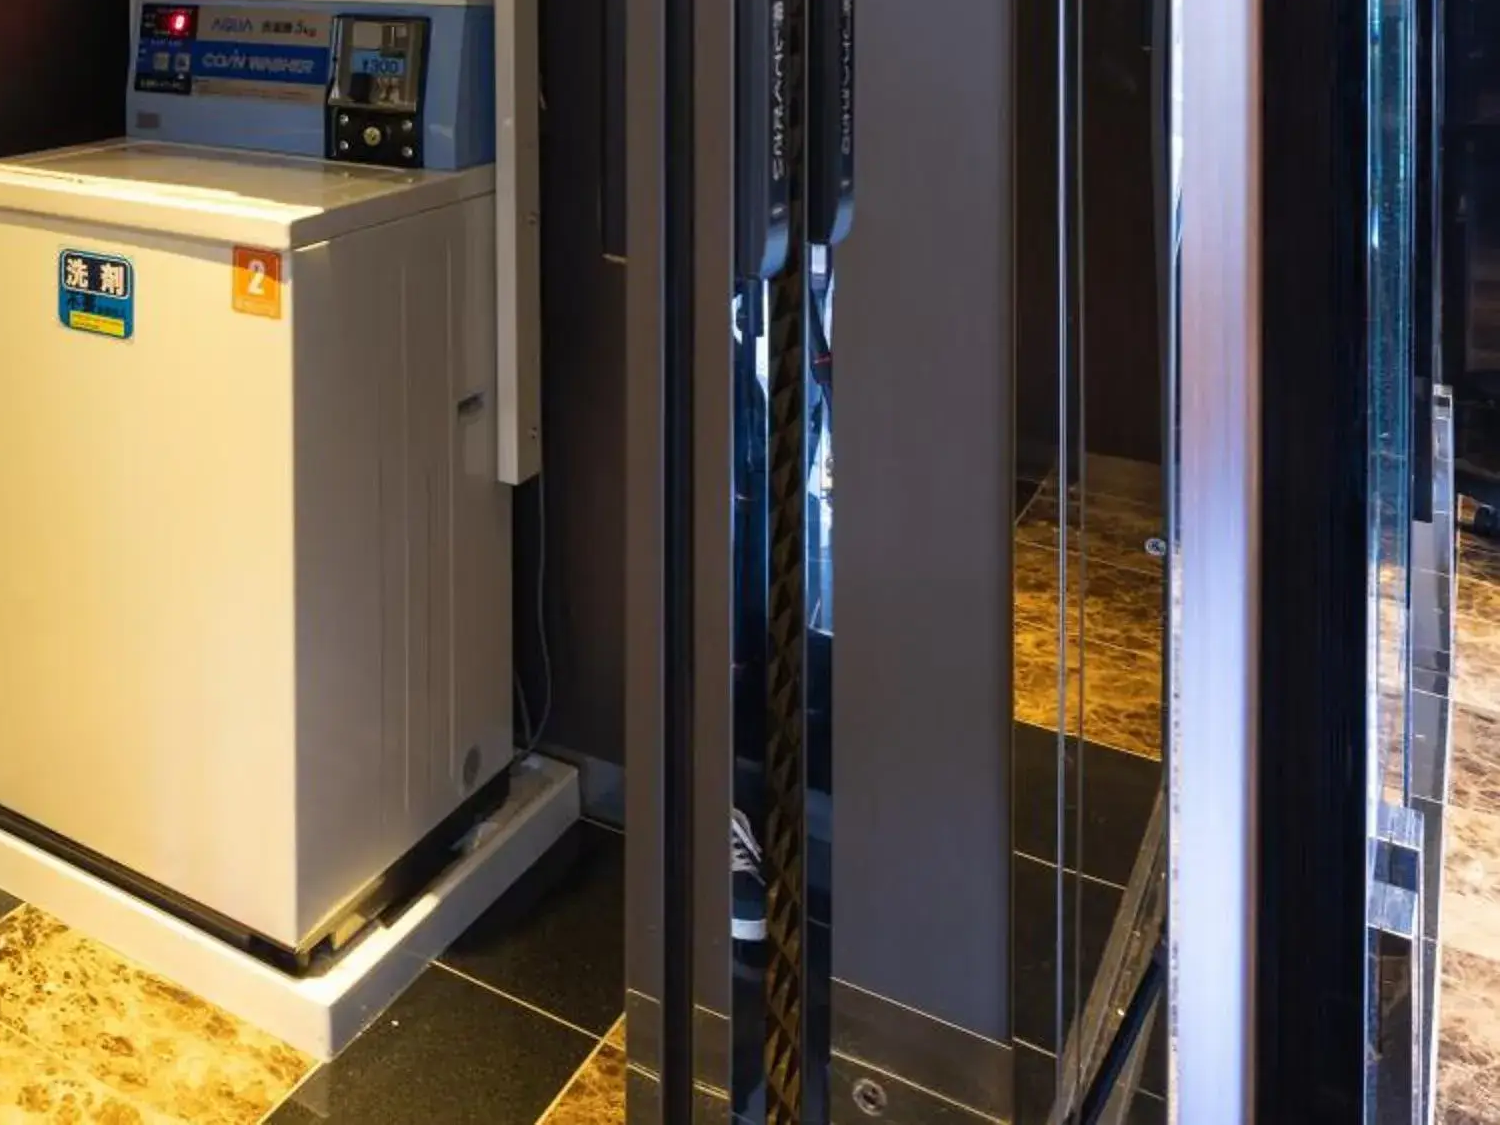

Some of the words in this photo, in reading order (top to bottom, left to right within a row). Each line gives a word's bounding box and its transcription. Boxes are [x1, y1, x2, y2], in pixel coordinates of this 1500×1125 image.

[248, 55, 316, 74] WASHER
[66, 257, 125, 296] 洗剤
[247, 259, 265, 295] 2
